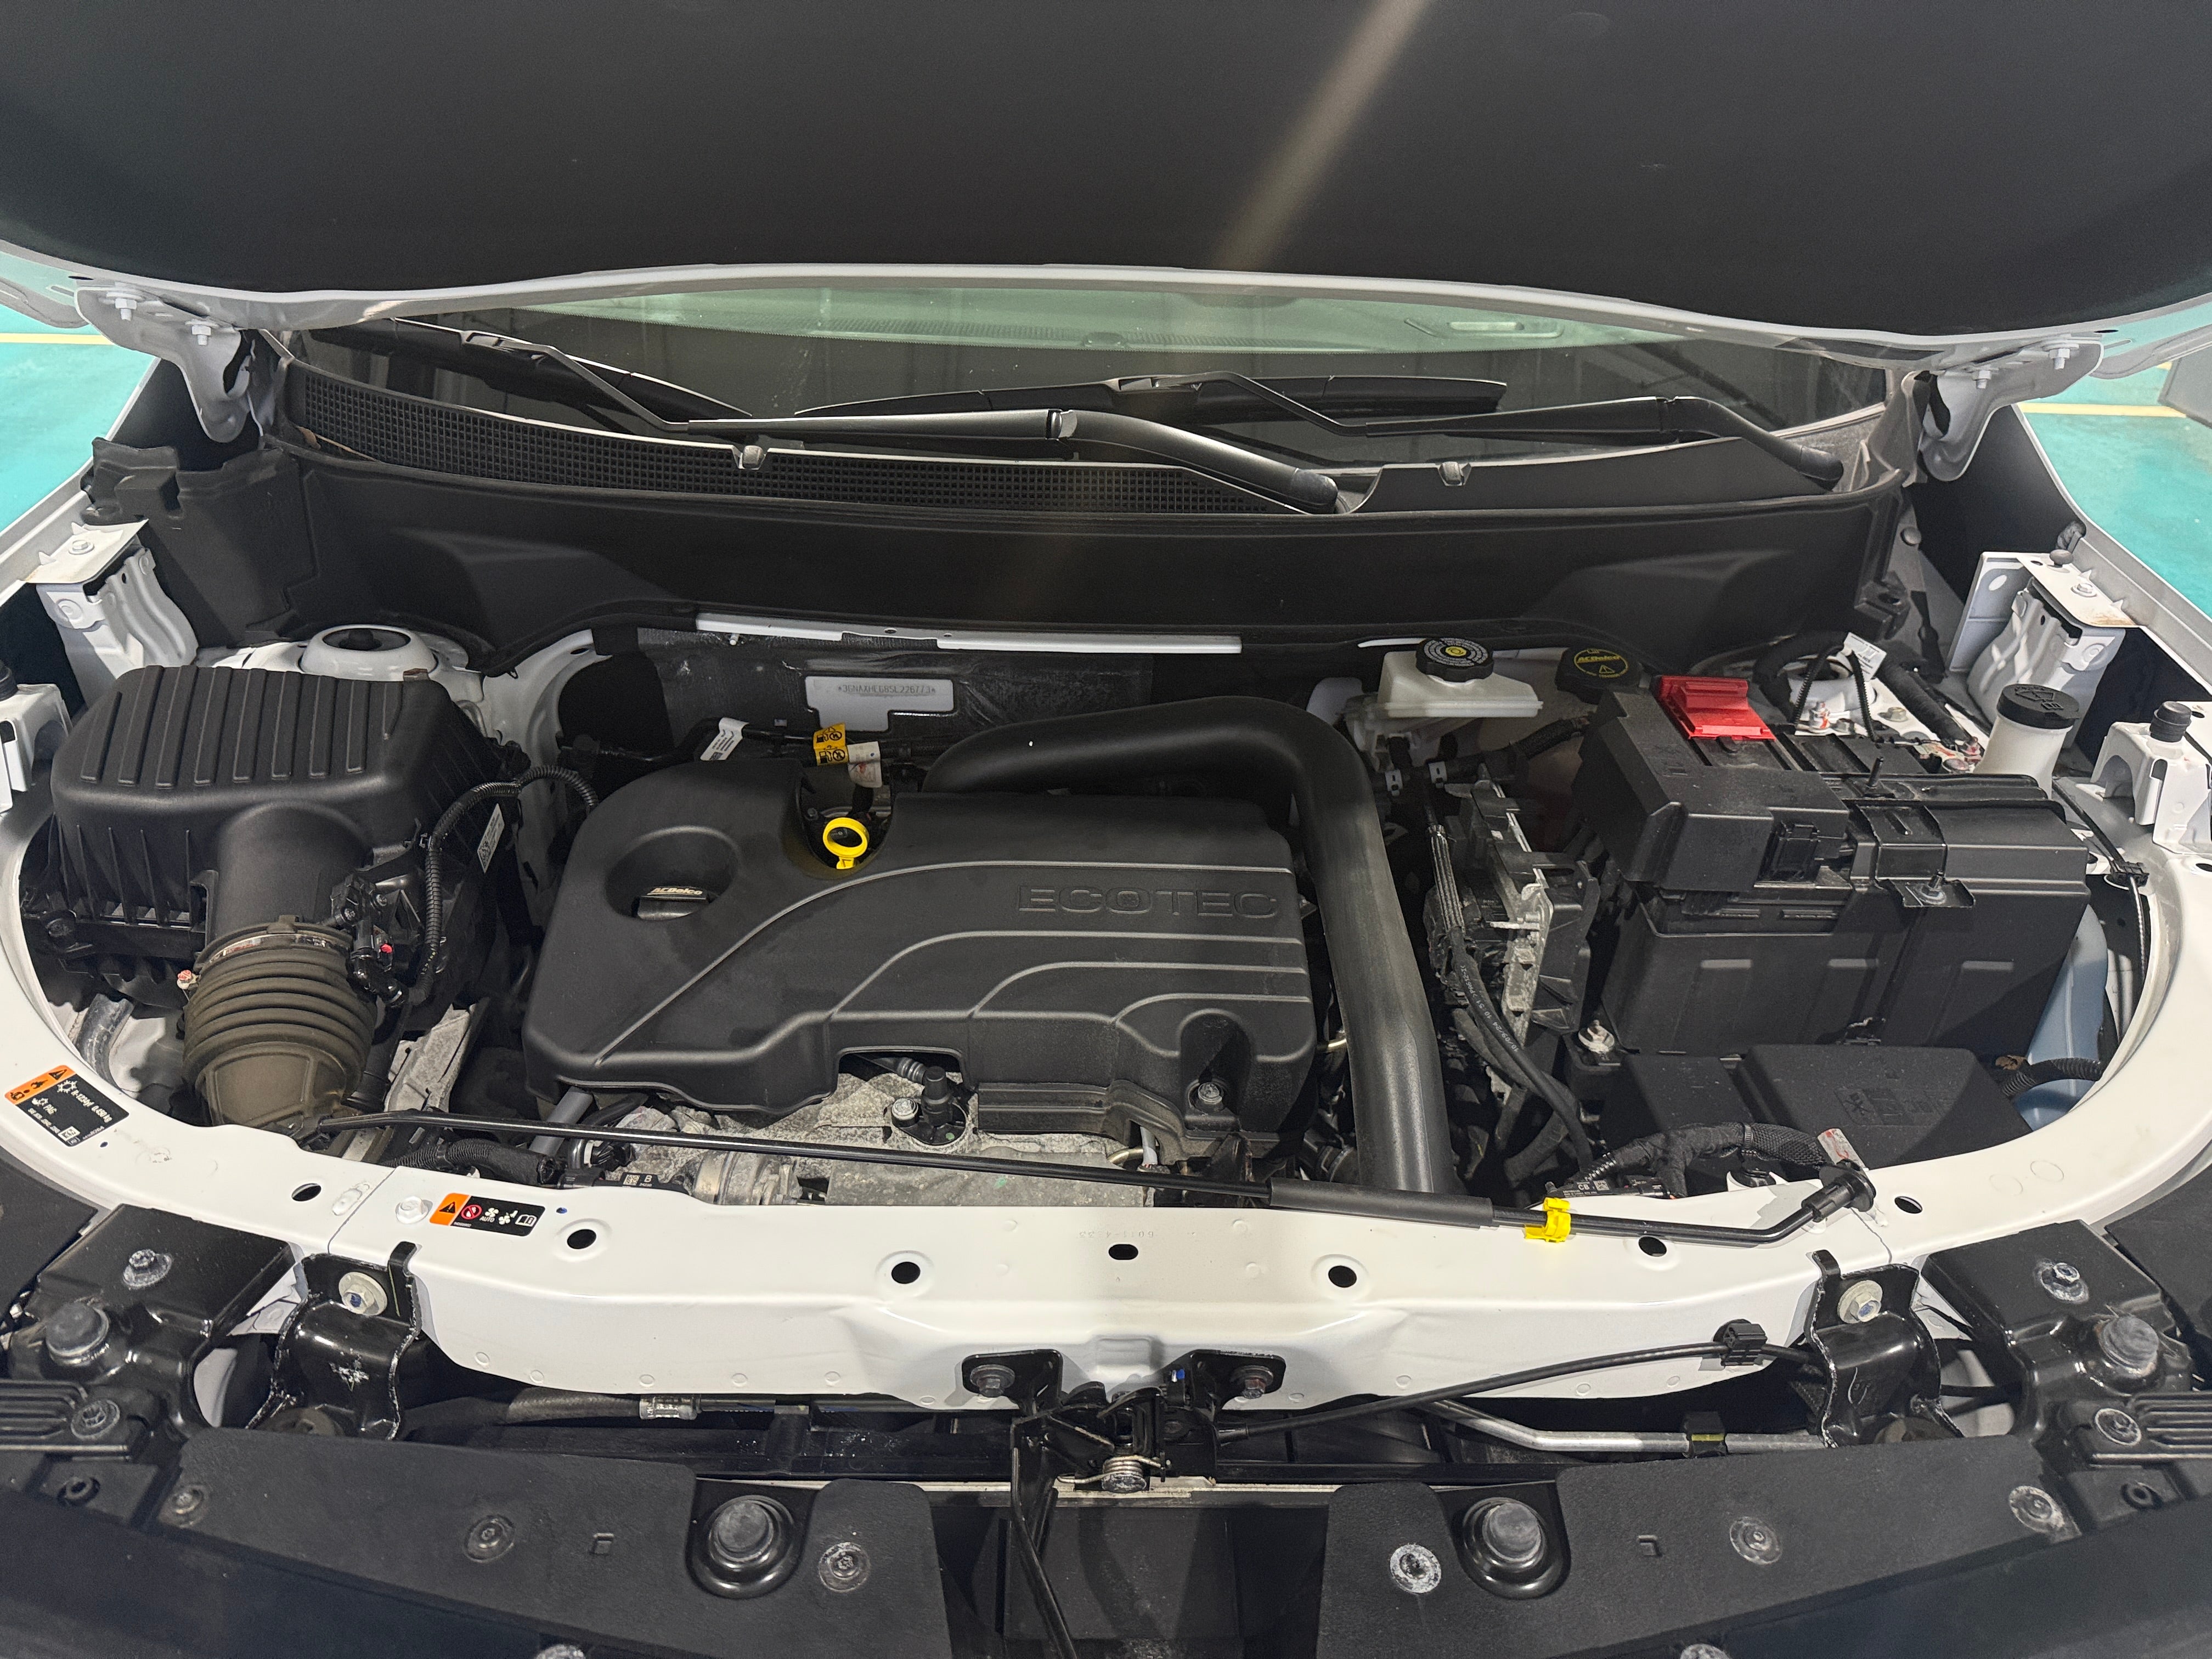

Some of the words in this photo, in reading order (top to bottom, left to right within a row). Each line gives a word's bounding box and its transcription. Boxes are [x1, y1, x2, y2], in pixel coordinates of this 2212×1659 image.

[1018, 885, 1278, 918] ECOTEC
[71, 1090, 95, 1107] R-1234yf
[43, 1104, 57, 1115] PAG
[644, 1175, 653, 1183] B
